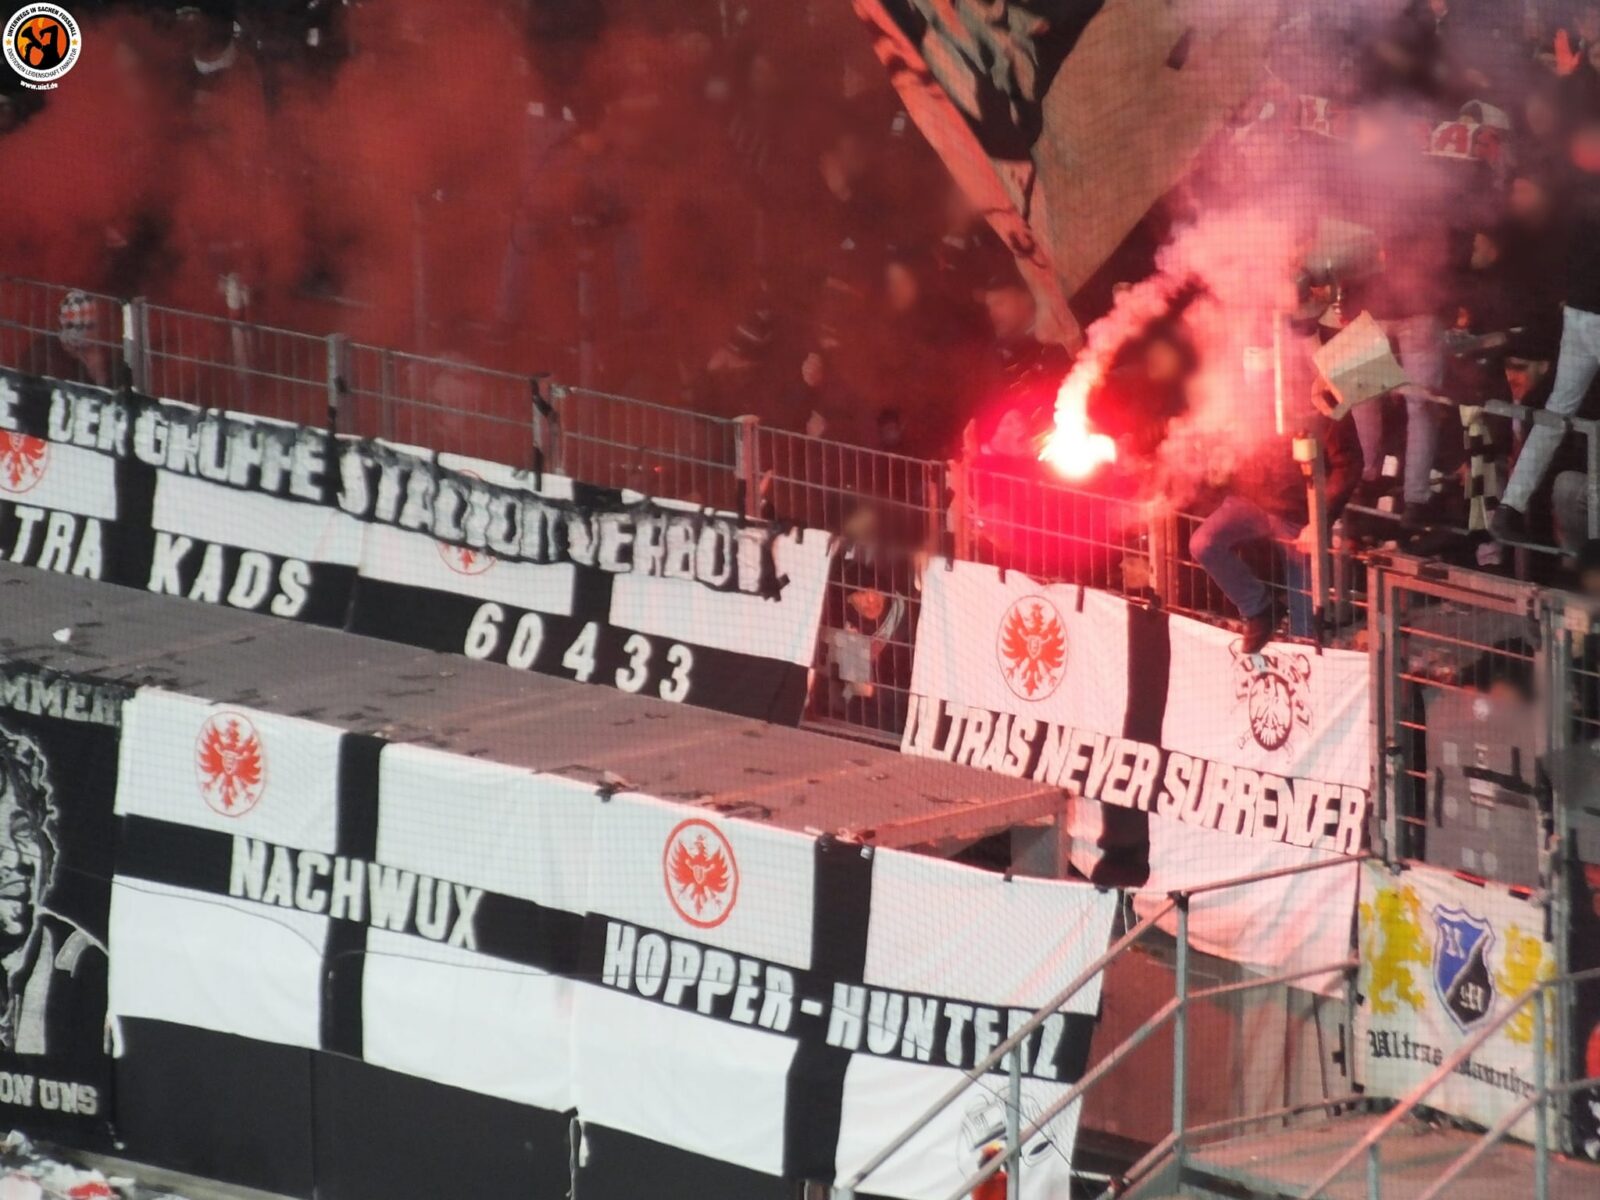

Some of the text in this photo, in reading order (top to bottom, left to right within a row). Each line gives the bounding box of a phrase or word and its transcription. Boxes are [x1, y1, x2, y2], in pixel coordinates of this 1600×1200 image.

[48, 388, 128, 457] DER
[0, 504, 103, 580] TRA
[147, 532, 314, 618] KAOS
[900, 694, 1367, 856] ULTRAS NEVER SURRENDER
[228, 834, 484, 951] NACHWUX
[1369, 1029, 1443, 1066] Ultras
[38, 1078, 98, 1116] UNS
